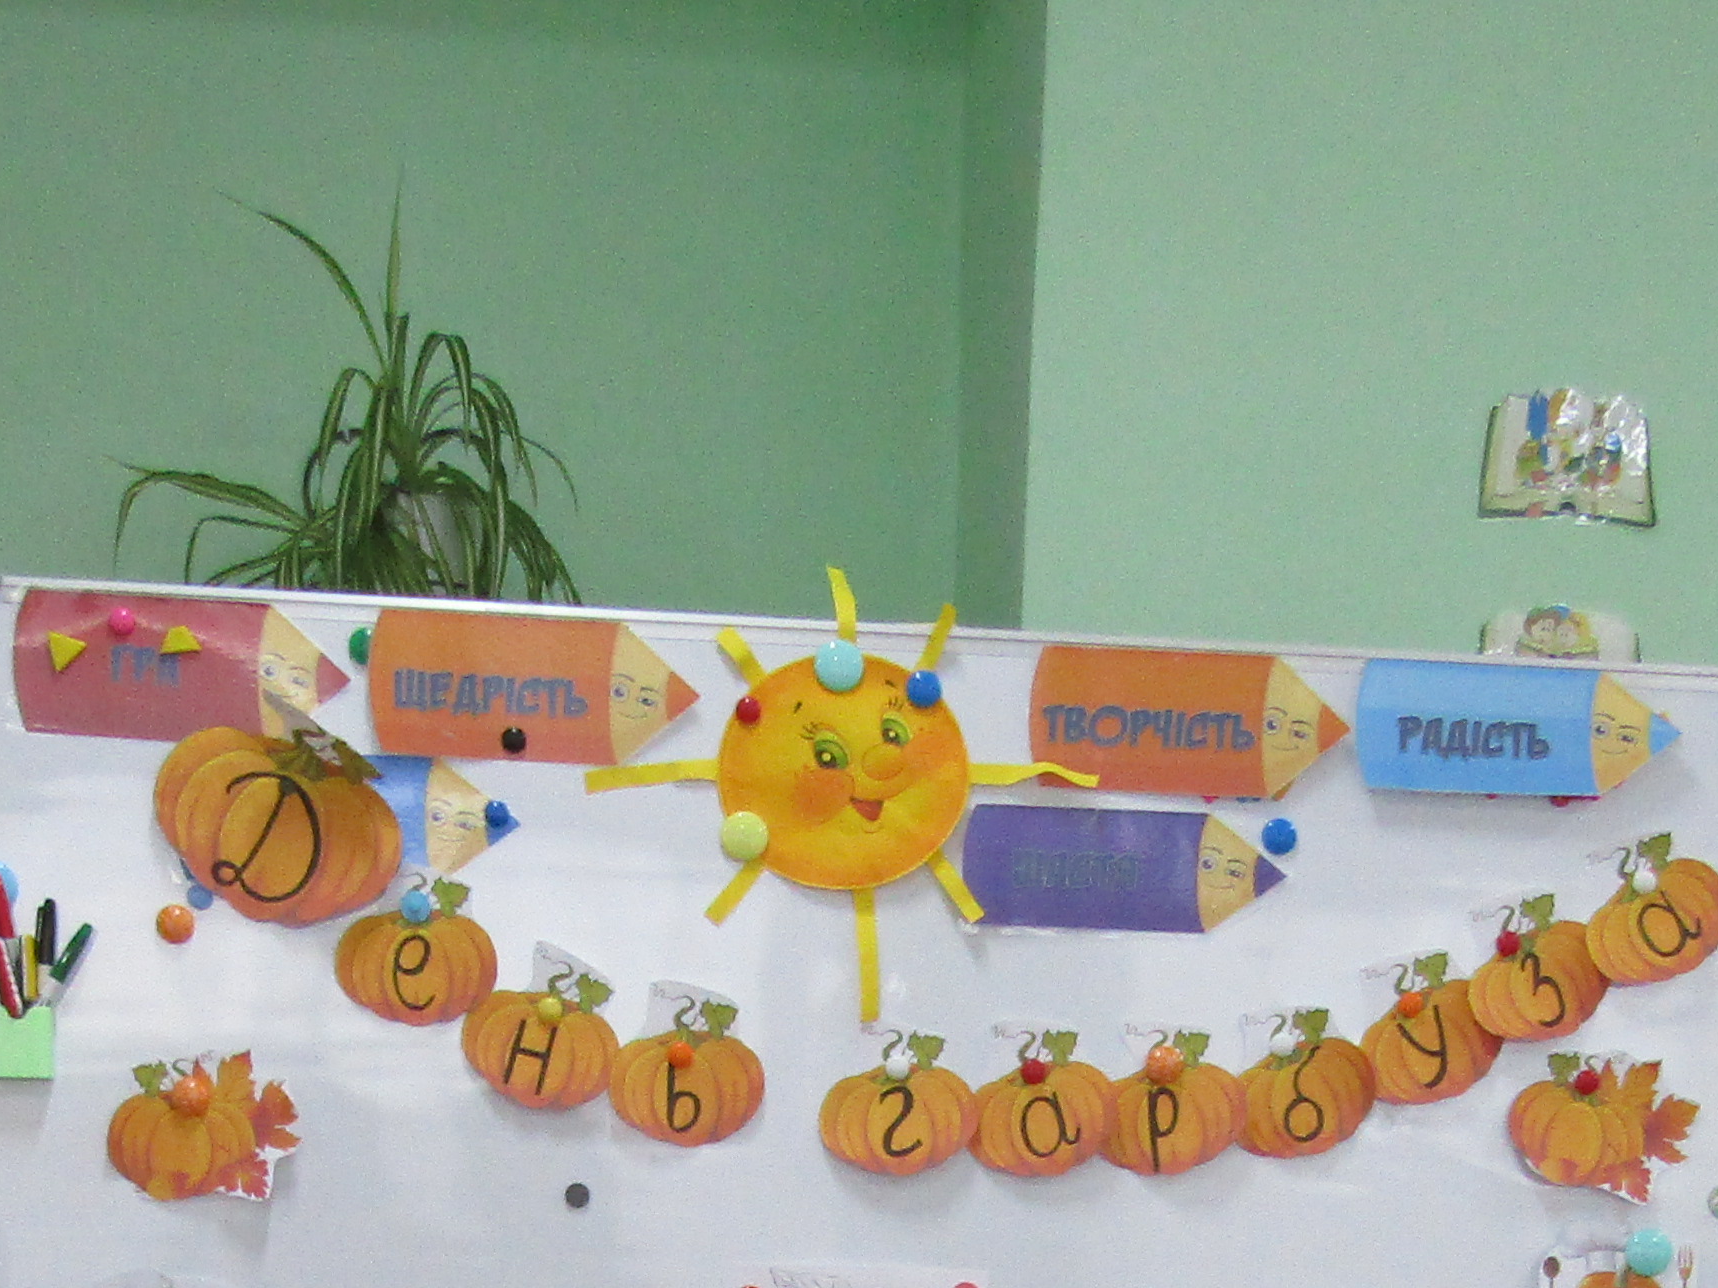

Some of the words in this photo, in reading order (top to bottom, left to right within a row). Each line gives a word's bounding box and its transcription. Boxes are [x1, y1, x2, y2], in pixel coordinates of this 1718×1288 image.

[393, 668, 589, 718] ЩЕДРІСТЬ
[1042, 703, 1256, 752] ТВОРЧІСТЬ
[1397, 715, 1550, 761] РАДІСТЬ
